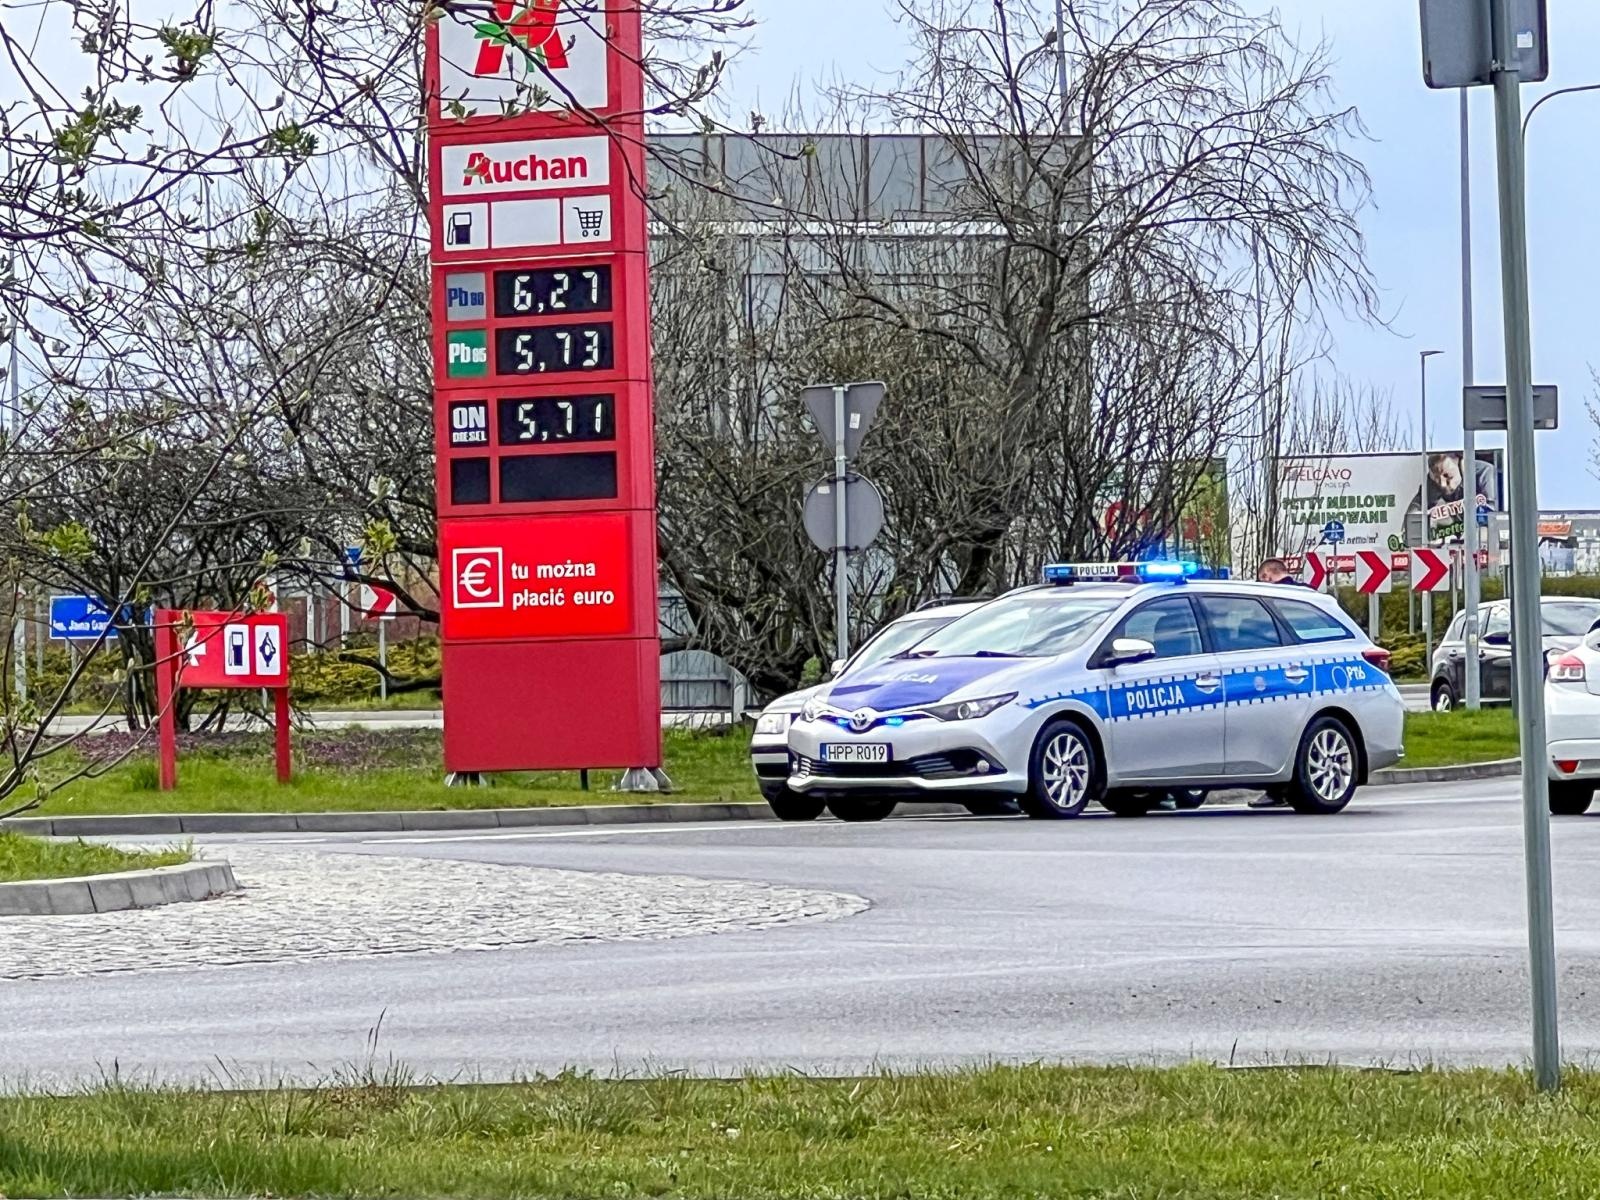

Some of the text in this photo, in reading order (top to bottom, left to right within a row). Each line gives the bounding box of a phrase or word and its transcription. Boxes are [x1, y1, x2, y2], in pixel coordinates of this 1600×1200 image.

[463, 152, 588, 187] Auchan
[513, 271, 598, 312] 6,27
[515, 330, 600, 371] 5,73
[452, 406, 486, 430] ON
[518, 401, 602, 440] 5,71
[452, 430, 488, 443] DIESEL
[1326, 494, 1396, 510] MEBLOWE
[511, 560, 596, 579] tu można
[1079, 565, 1117, 576] POLICJA
[512, 587, 615, 611] płacić euro
[1126, 684, 1185, 712] POLICJA
[828, 745, 853, 760] HPP
